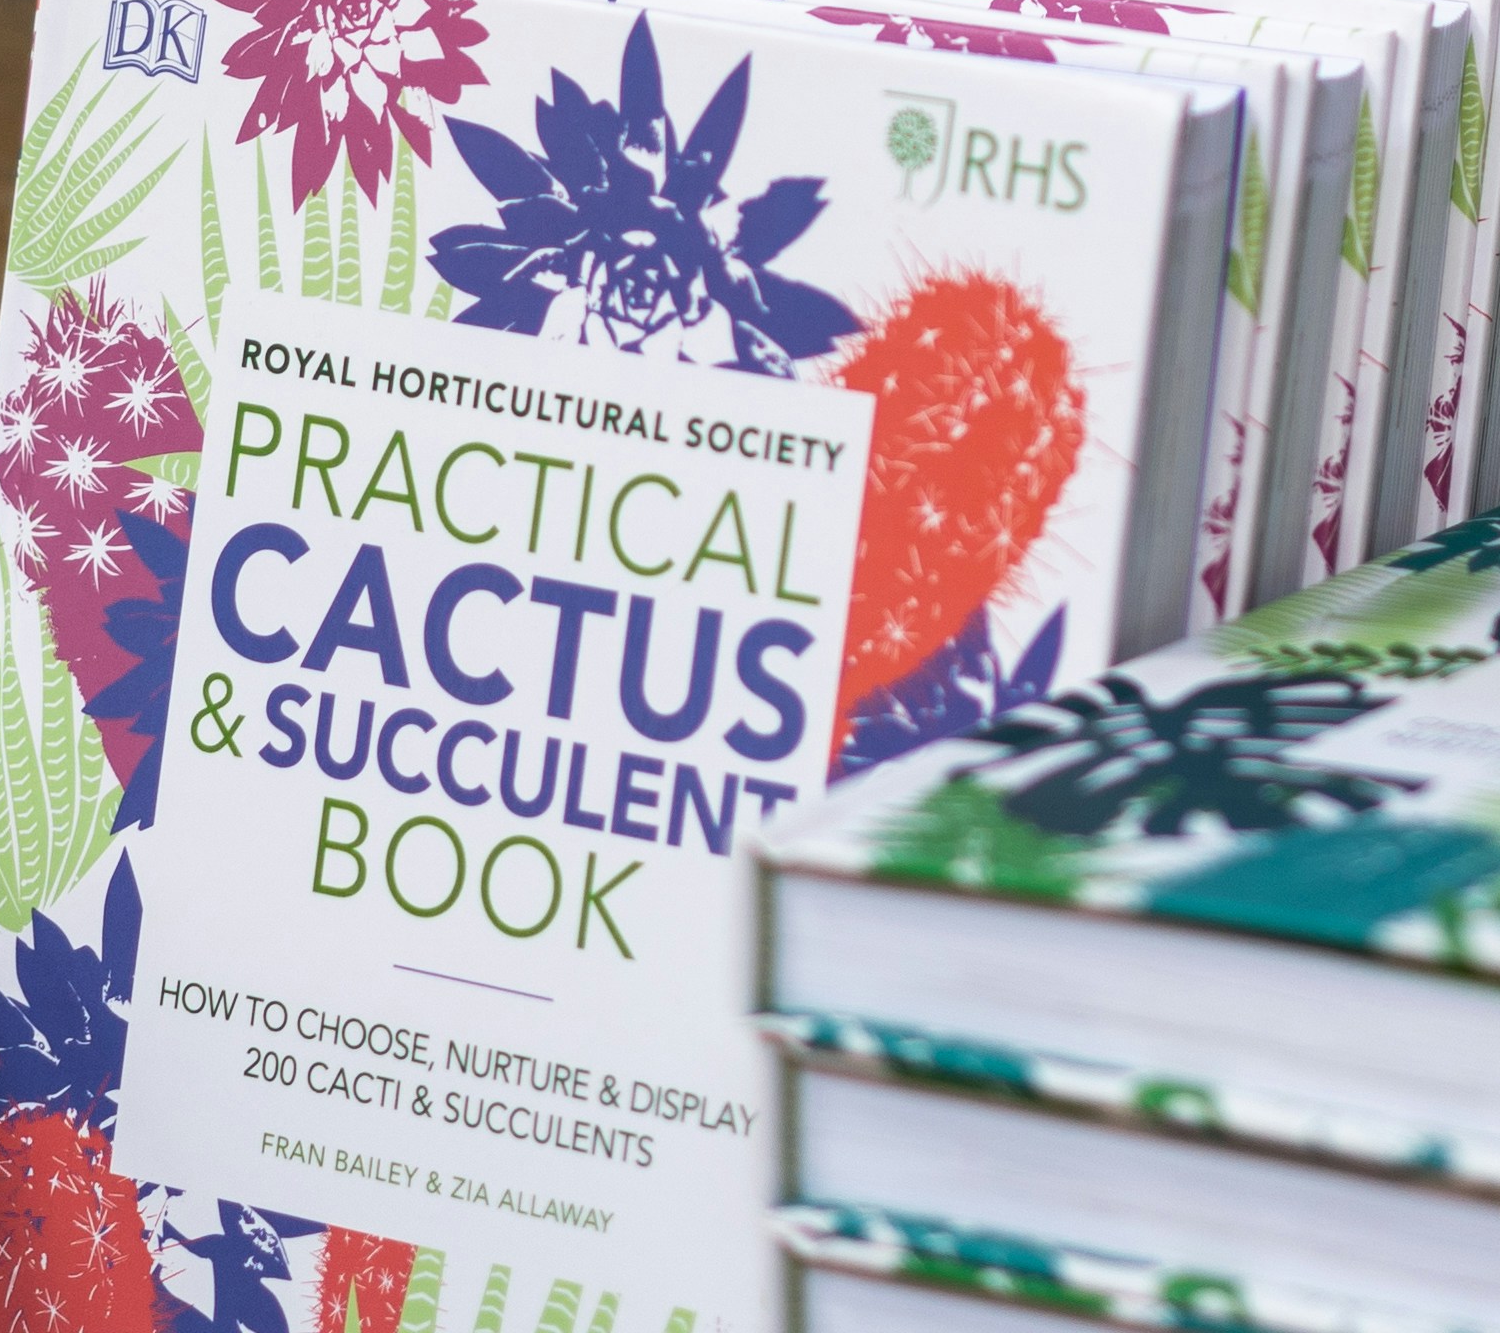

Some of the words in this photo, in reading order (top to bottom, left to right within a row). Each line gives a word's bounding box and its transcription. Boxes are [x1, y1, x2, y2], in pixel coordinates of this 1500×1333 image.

[958, 126, 1090, 214] RHS
[240, 338, 358, 390] ROYAL
[371, 361, 670, 445] HORTICULTURAL
[685, 416, 846, 474] SOCIETY
[224, 400, 824, 608] PRACTICAL
[209, 521, 817, 764] CACTUS
[189, 672, 245, 760] &
[257, 684, 797, 858] SUCCULENT
[311, 796, 646, 963] BOOK
[158, 975, 239, 1023] HOW
[245, 993, 289, 1033] TO
[295, 1006, 435, 1073] CHOOSE,
[443, 1038, 591, 1103] NURTURE
[598, 1074, 622, 1109] &
[629, 1080, 761, 1139] DISPLAY
[242, 1045, 298, 1089] 200
[304, 1061, 402, 1112] CACTI
[409, 1084, 435, 1118] &
[441, 1090, 656, 1169] SUCCULENTS
[259, 1132, 326, 1168] FRAN
[333, 1147, 420, 1191] BAILEY
[424, 1169, 444, 1195] &
[449, 1174, 491, 1208] ZIA
[497, 1187, 616, 1236] ALLAWAY
